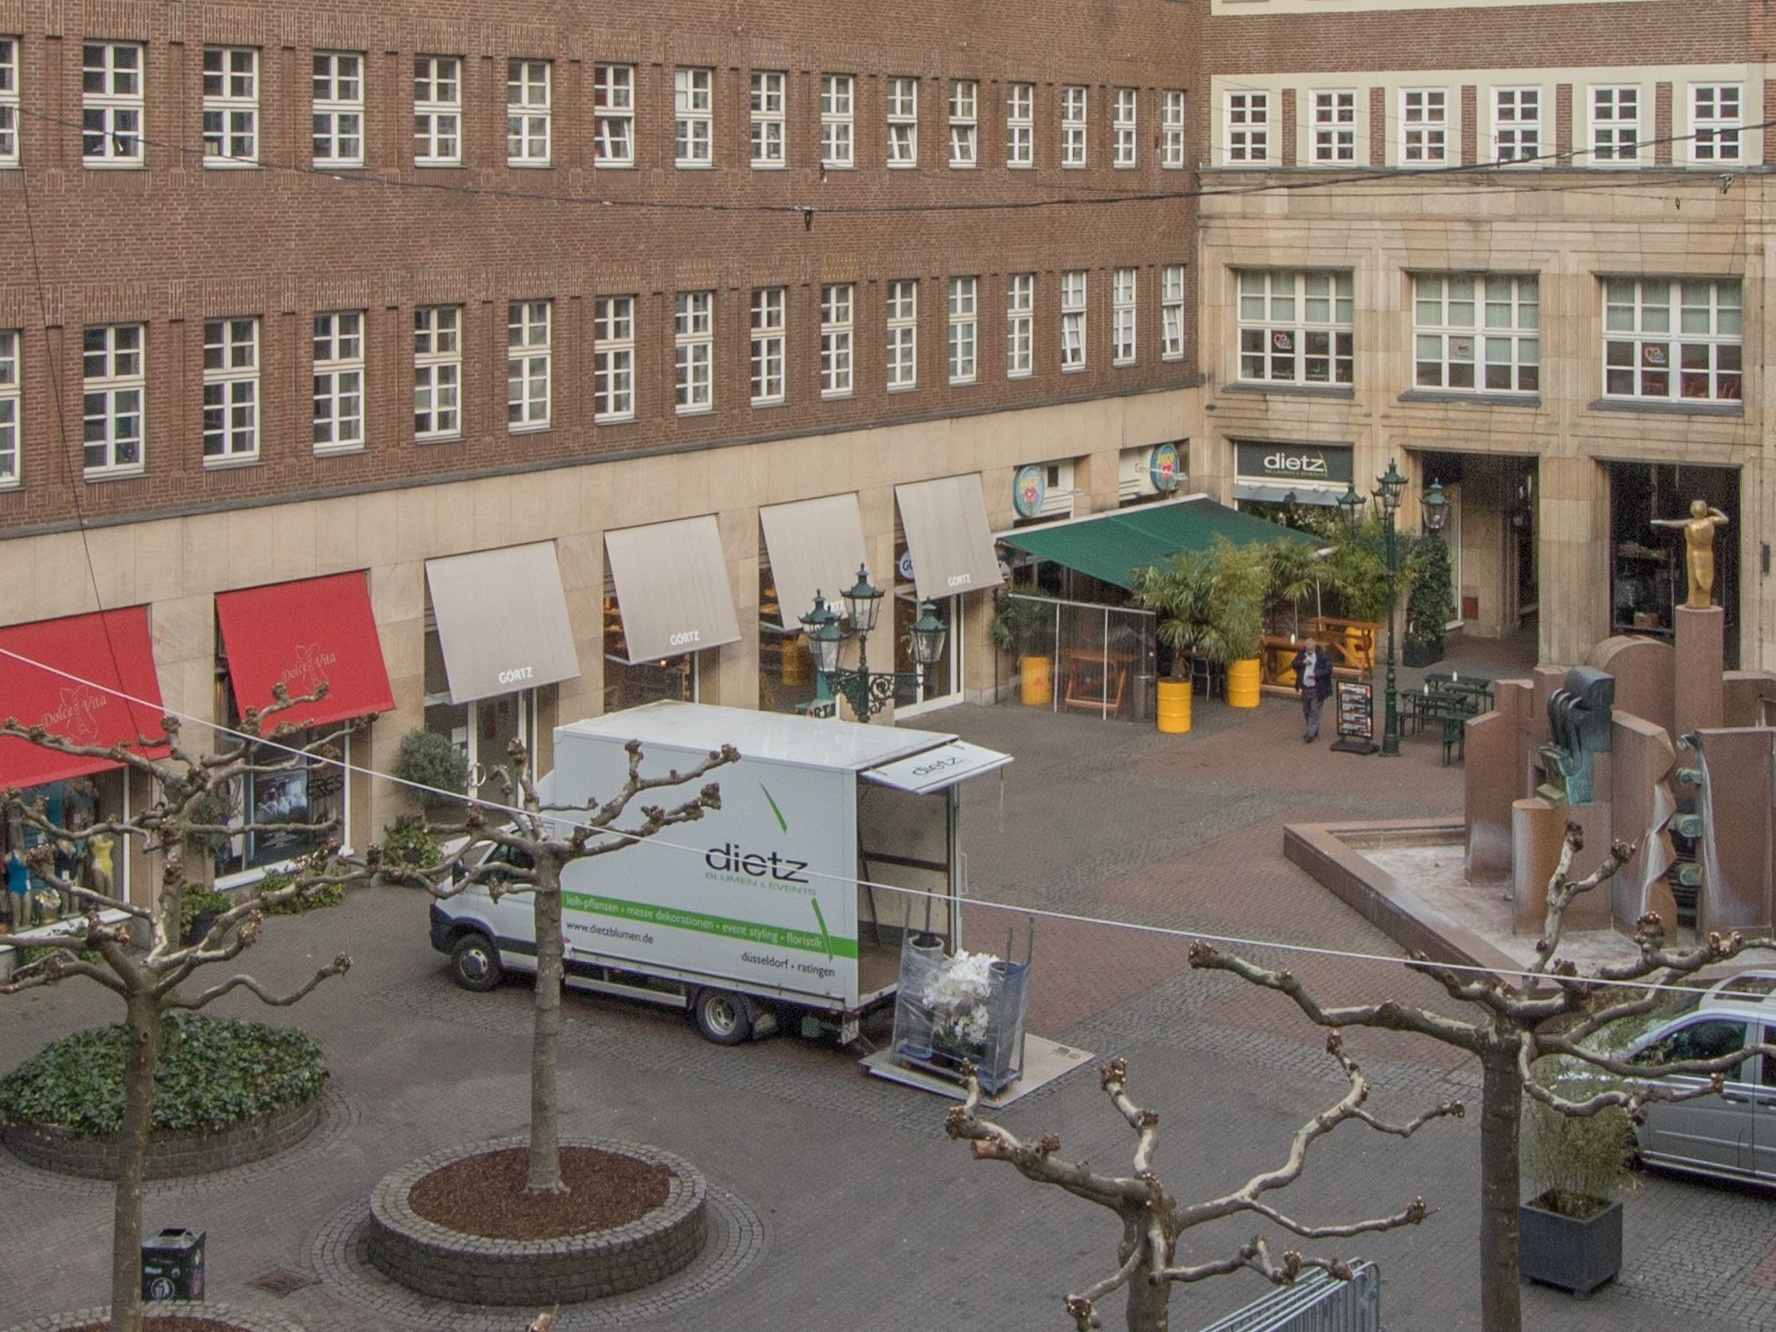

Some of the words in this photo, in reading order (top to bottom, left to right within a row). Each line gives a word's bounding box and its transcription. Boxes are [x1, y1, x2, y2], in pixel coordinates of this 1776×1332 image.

[1263, 452, 1325, 472] dietz
[669, 630, 701, 646] GÖRTZ
[498, 667, 534, 684] GÖRTZ
[705, 843, 809, 884] dietz
[706, 872, 757, 886] BLUMEN
[768, 881, 817, 896] EVENTS
[566, 922, 654, 944] www.dietzblumen.de
[626, 908, 654, 919] messe
[655, 911, 713, 930] dekorationen
[722, 923, 747, 935] event
[749, 927, 779, 944] styling
[786, 931, 823, 949] floristik
[741, 951, 789, 970] düsseldorf
[797, 963, 836, 979] ratingen
